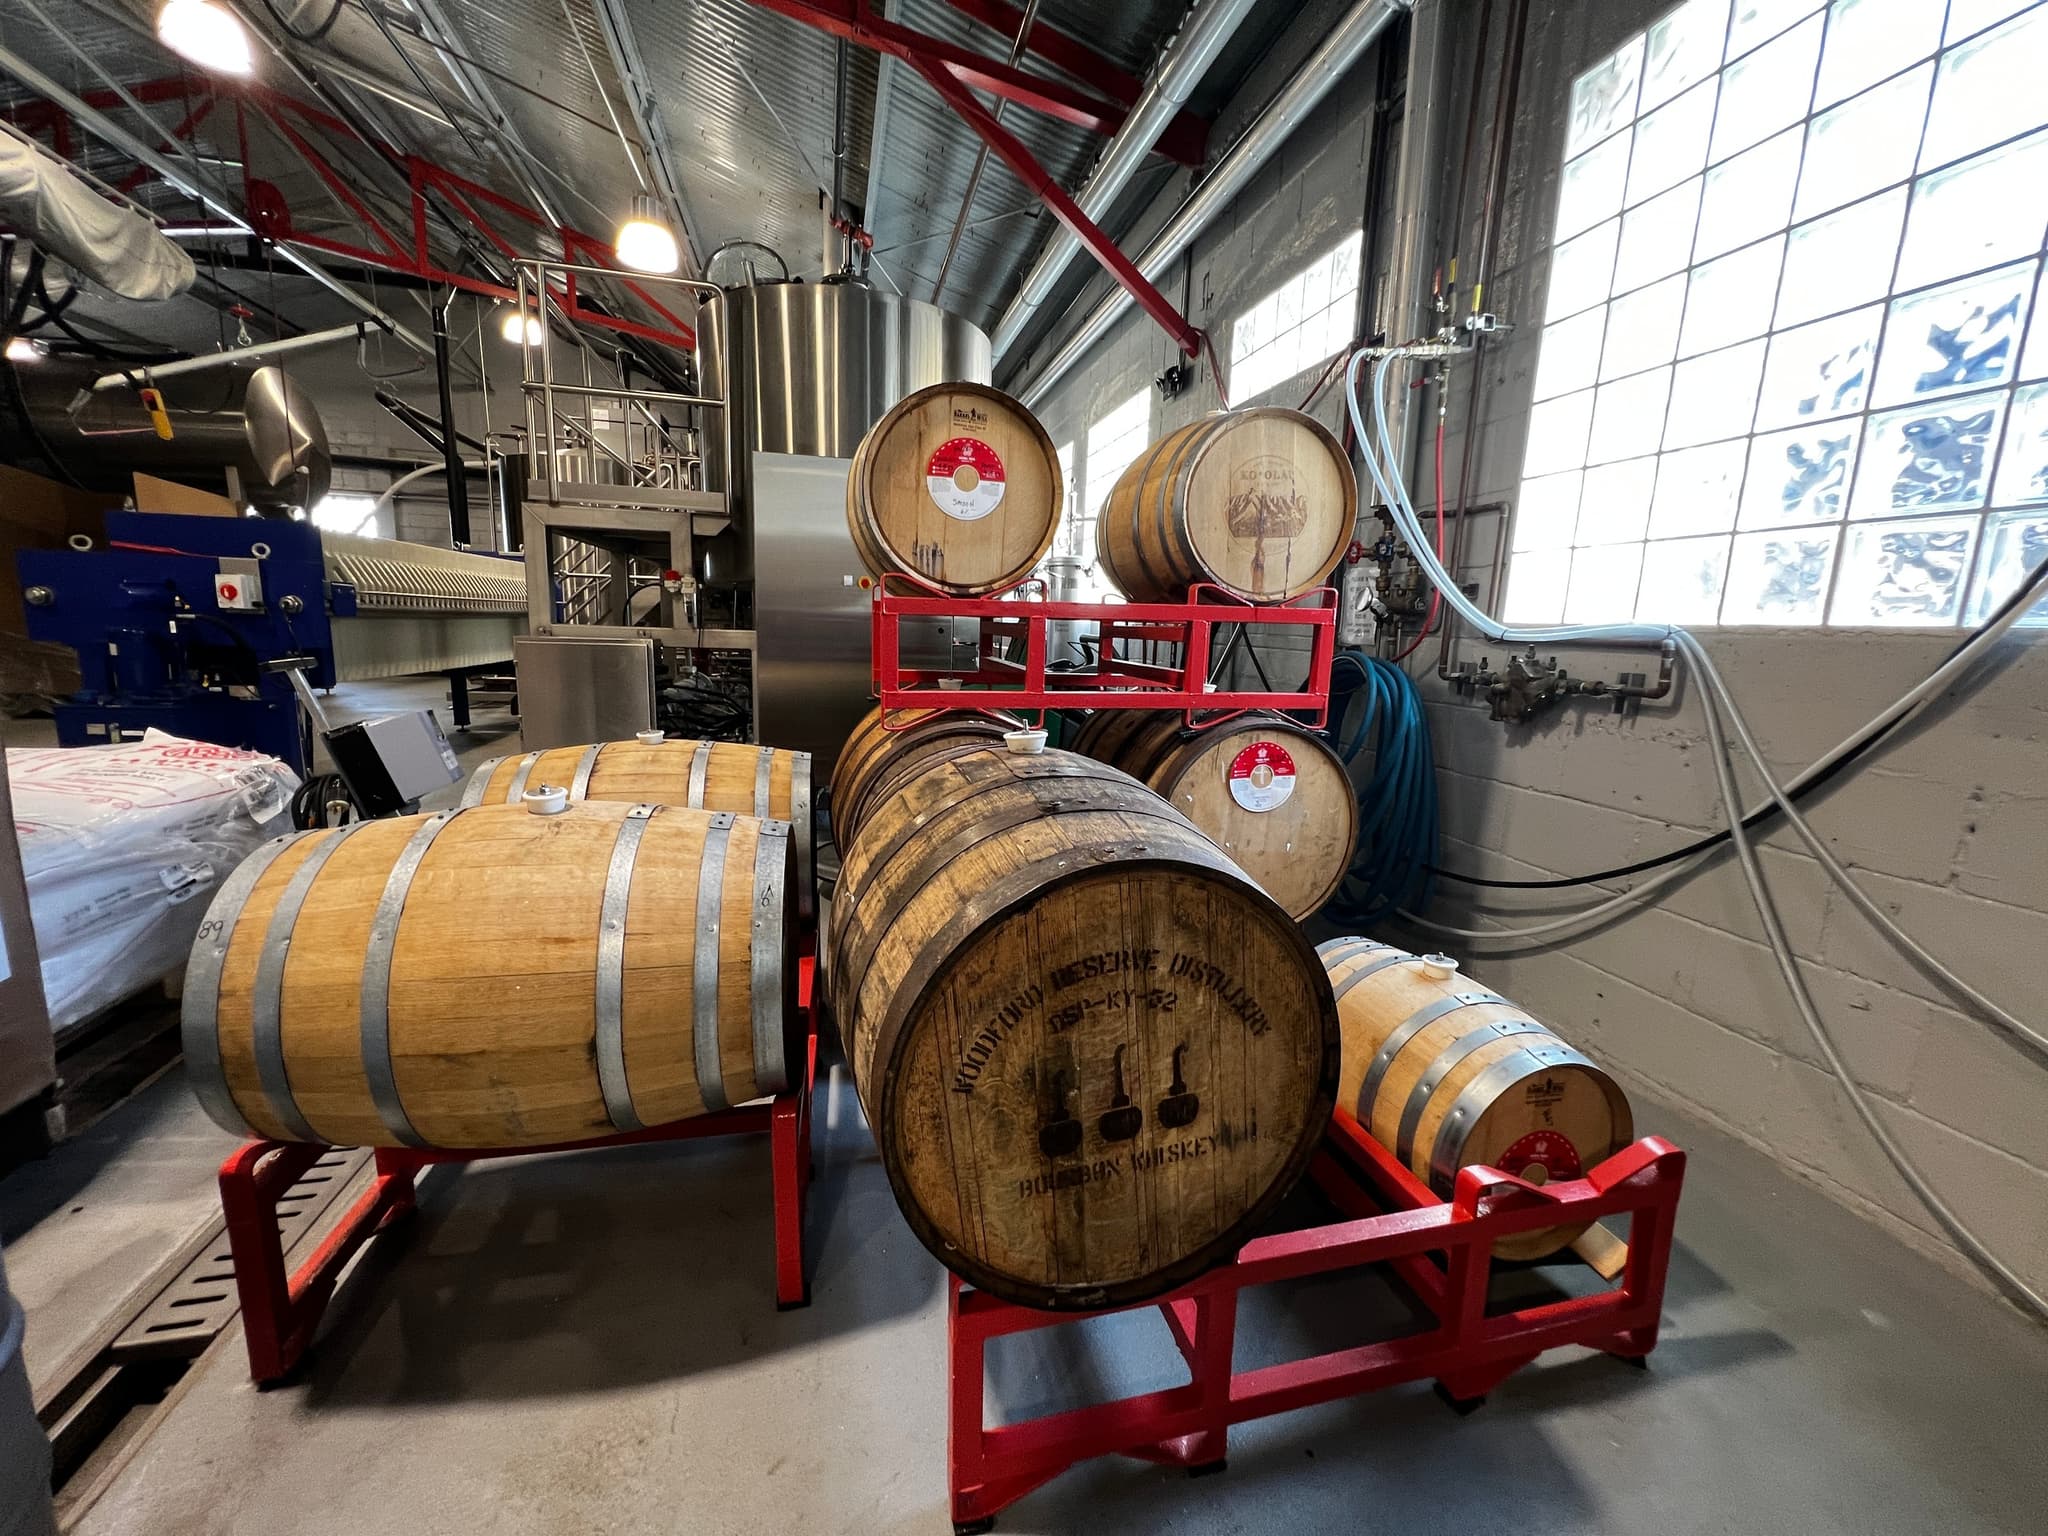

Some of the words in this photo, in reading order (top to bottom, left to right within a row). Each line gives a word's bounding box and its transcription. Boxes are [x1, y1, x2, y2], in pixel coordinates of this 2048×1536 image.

[198, 920, 224, 942] 89
[952, 984, 1044, 1094] WOODFORD
[1051, 949, 1161, 991] RESERVE
[1168, 952, 1272, 1036] DISTILLERY
[1130, 1135, 1218, 1172] WHISKEY
